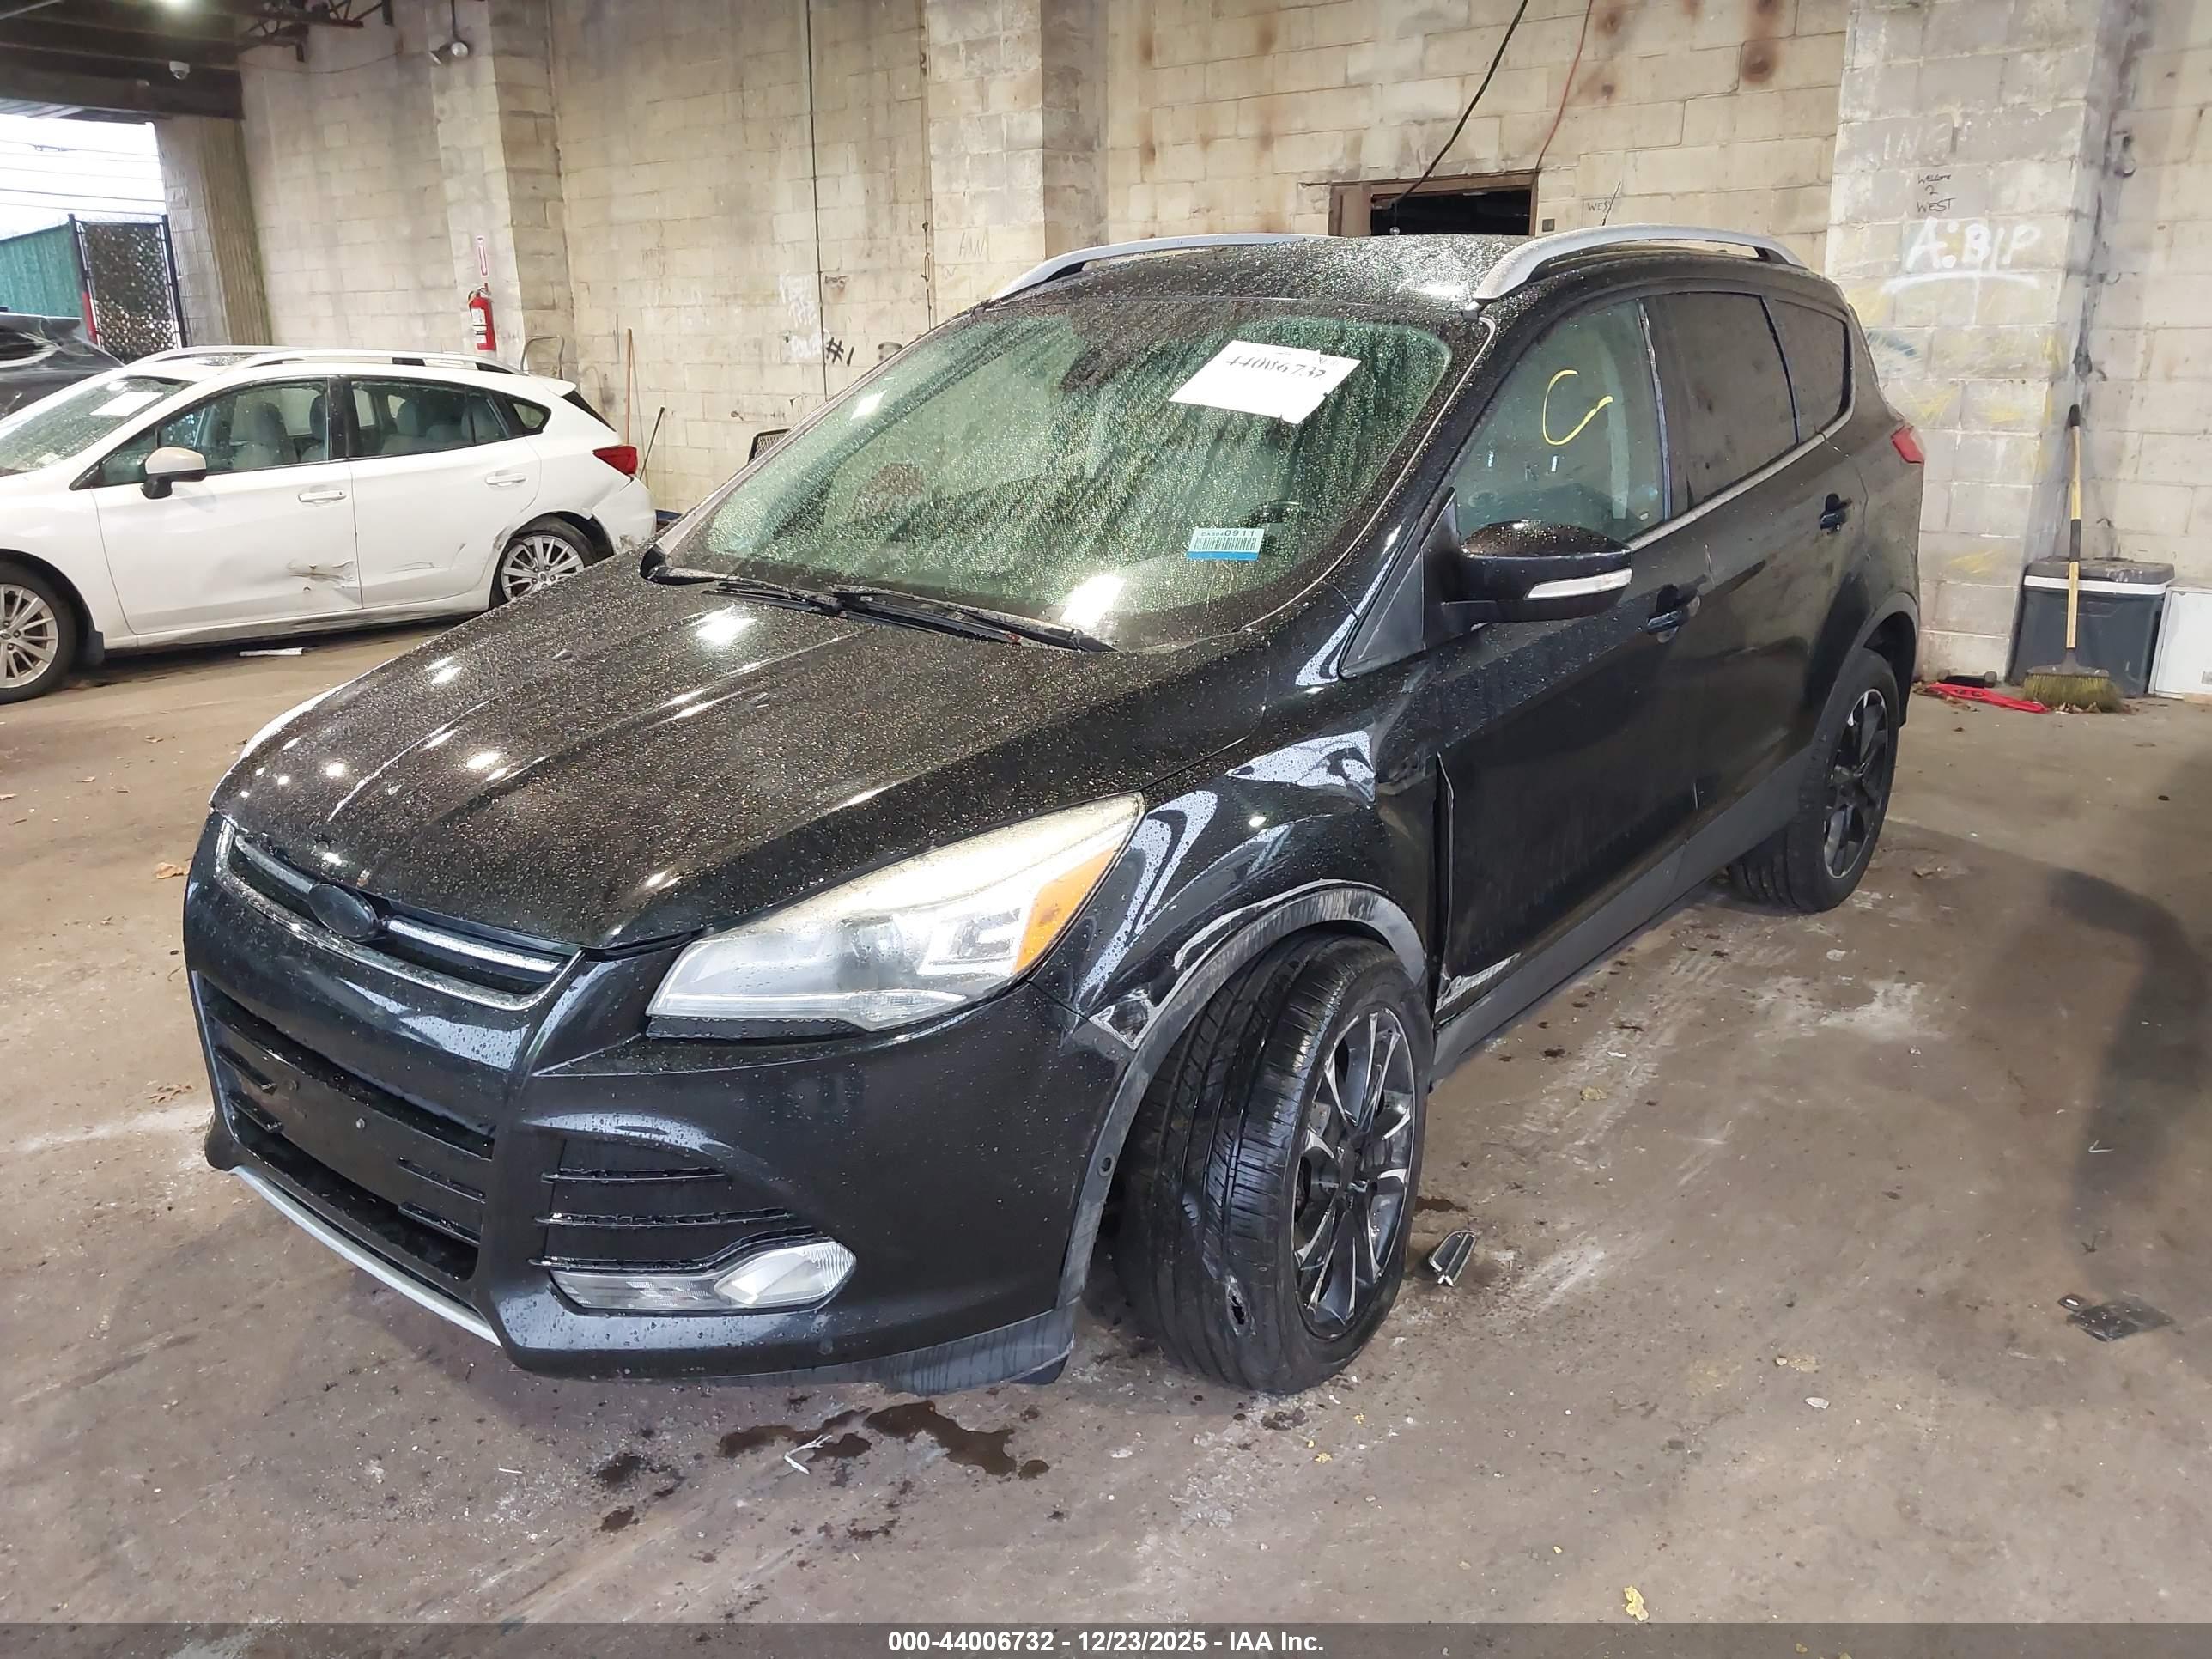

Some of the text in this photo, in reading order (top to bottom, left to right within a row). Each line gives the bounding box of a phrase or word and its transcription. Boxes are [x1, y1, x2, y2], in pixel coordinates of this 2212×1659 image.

[1924, 185, 1939, 195] 2
[1916, 198, 1958, 213] WEST
[825, 337, 855, 368] #1
